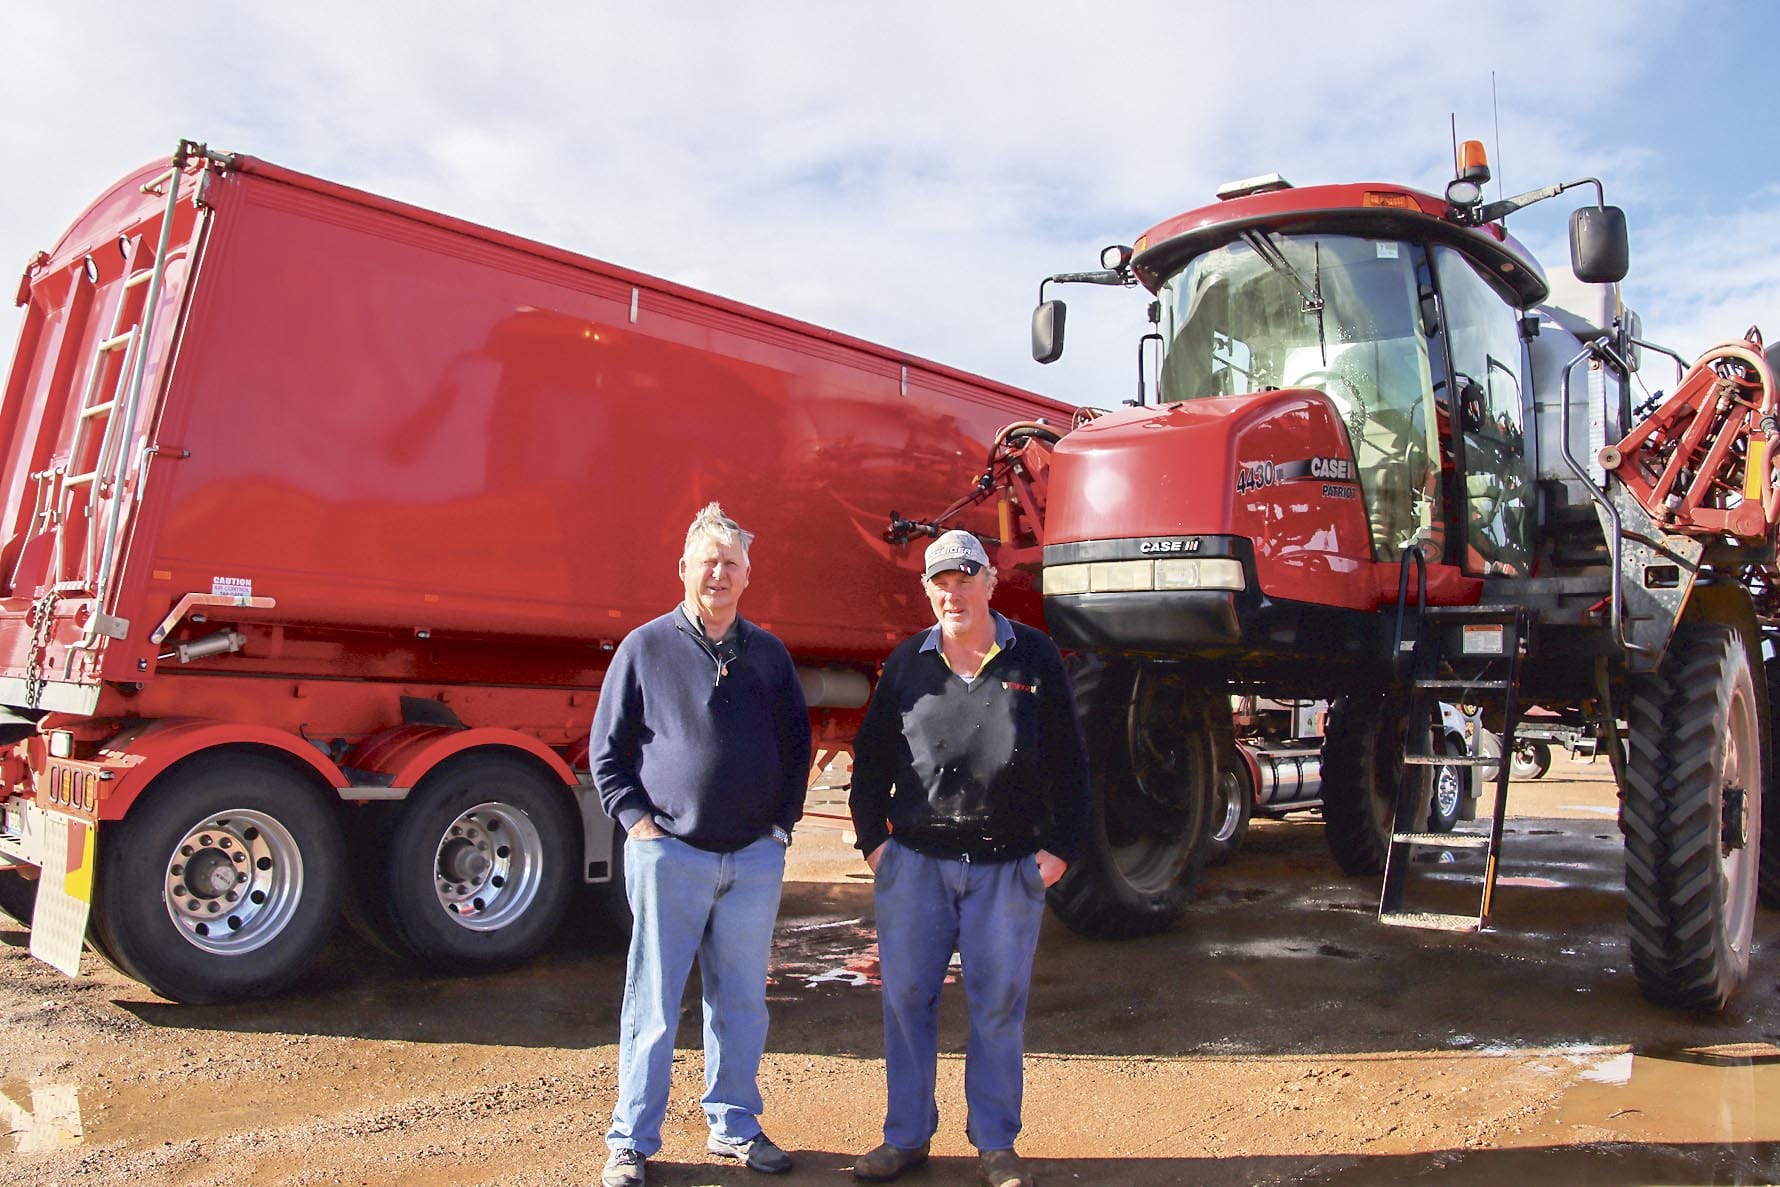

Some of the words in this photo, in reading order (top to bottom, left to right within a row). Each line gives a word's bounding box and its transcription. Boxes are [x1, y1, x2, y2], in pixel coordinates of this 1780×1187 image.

[1311, 457, 1346, 479] CASE
[1236, 460, 1273, 495] 4430
[1140, 540, 1182, 553] CASE
[213, 576, 251, 586] CAUTION
